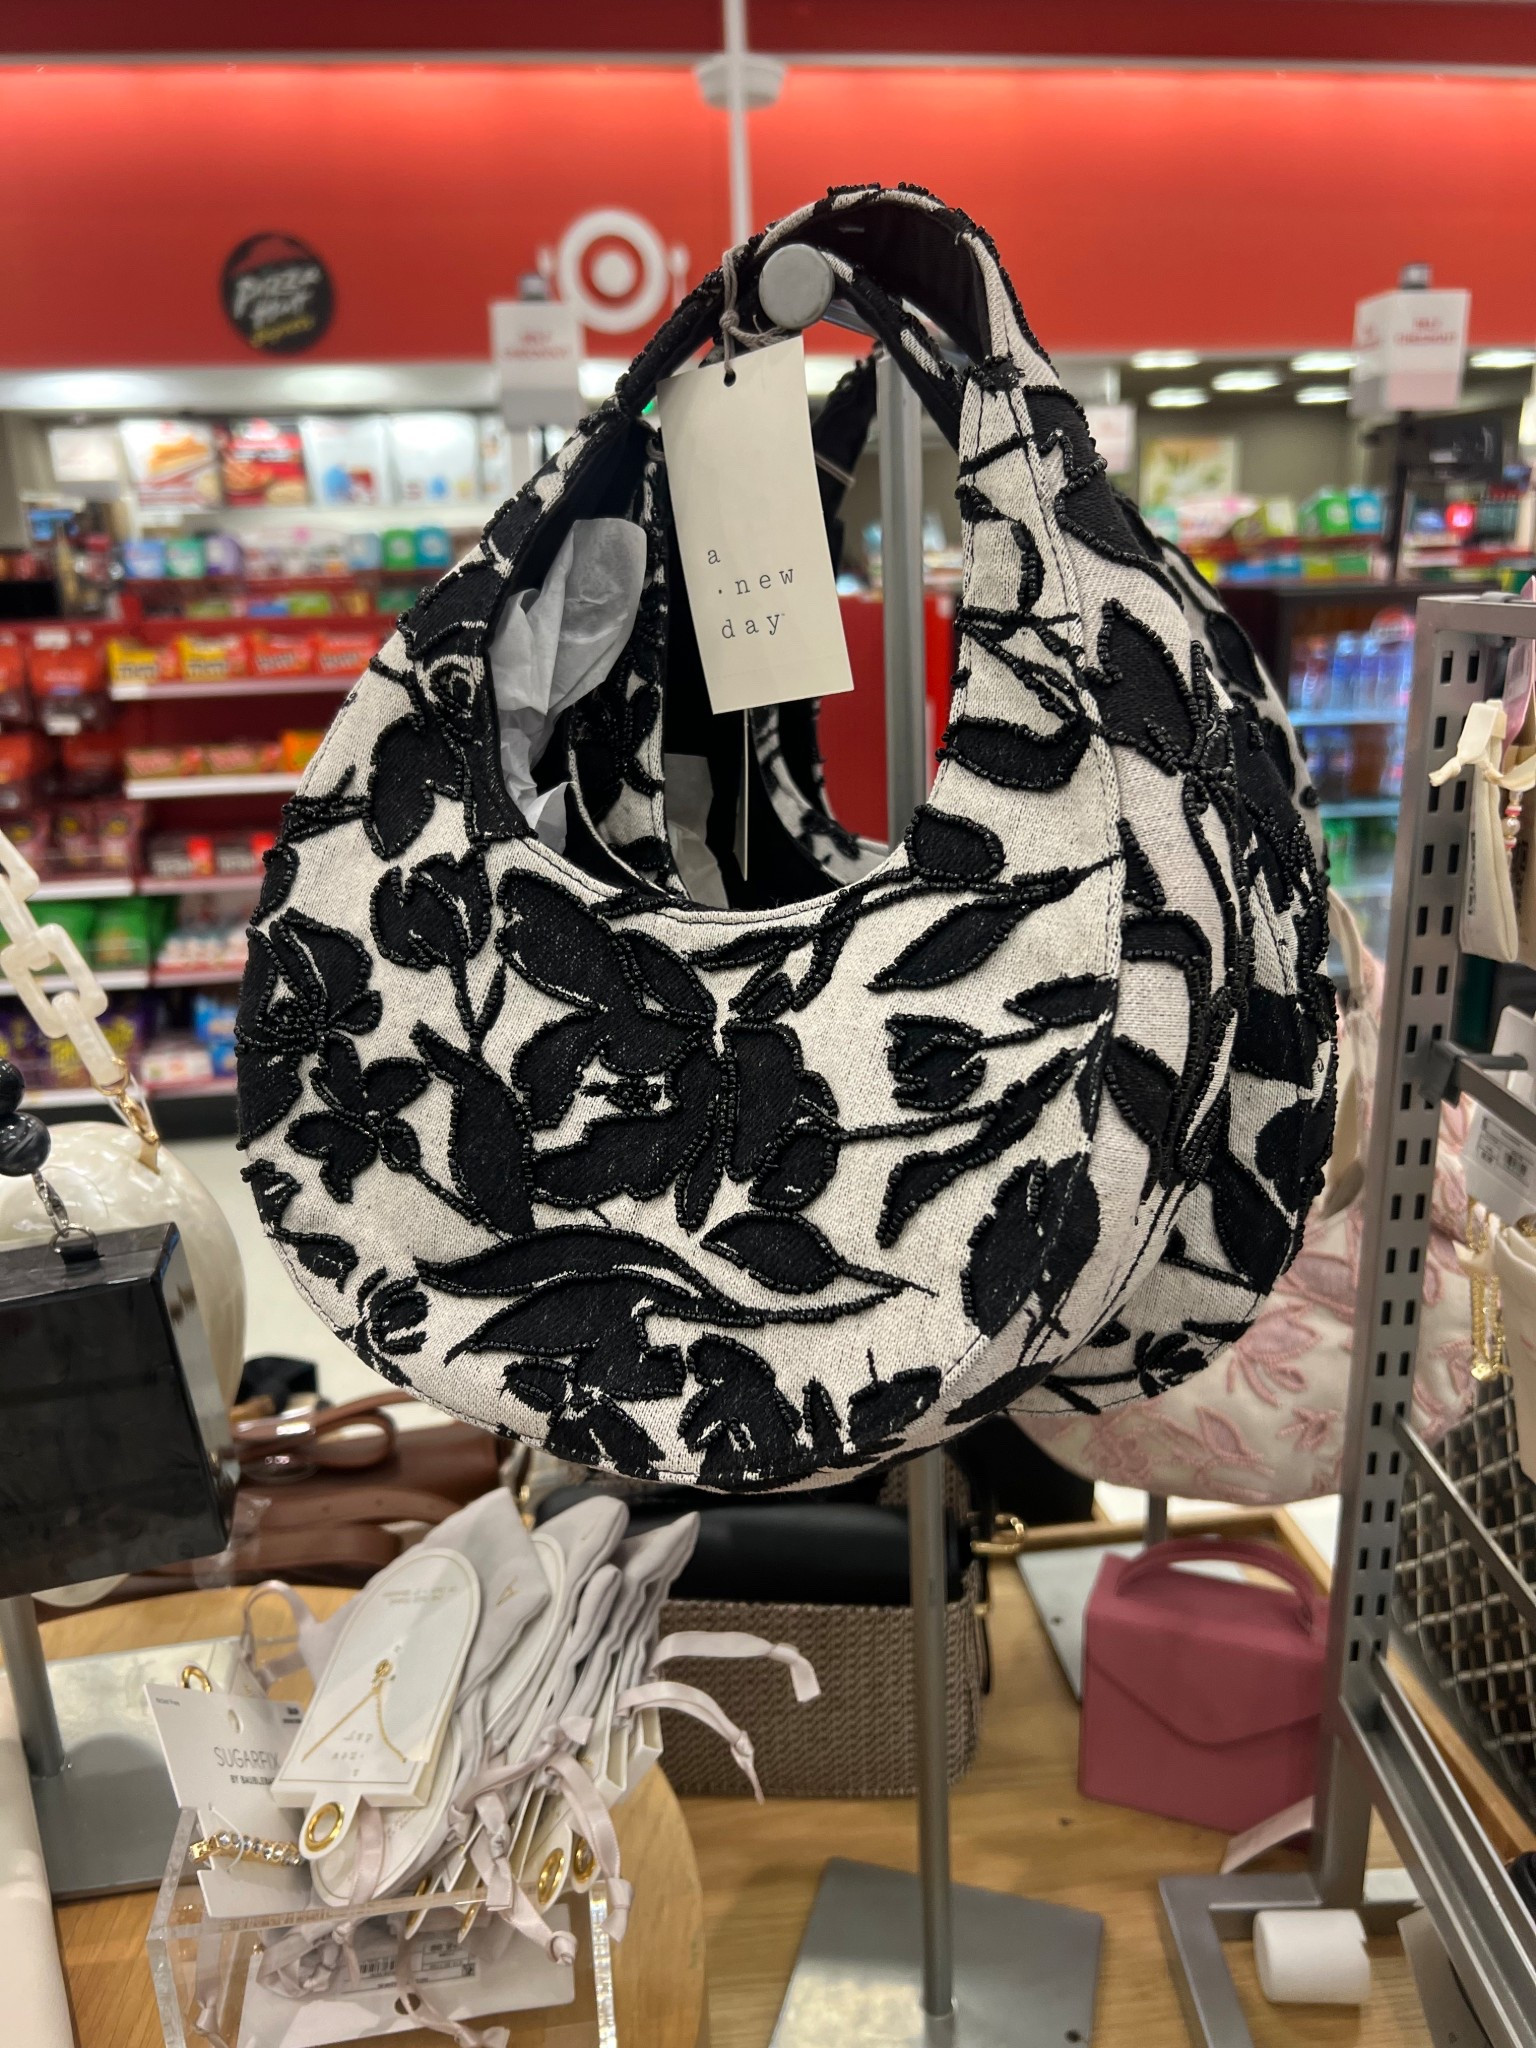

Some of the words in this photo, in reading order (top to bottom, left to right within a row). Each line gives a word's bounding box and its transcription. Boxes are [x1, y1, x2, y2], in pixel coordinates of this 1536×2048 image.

[707, 549, 721, 564] a
[721, 613, 785, 639] day
[214, 1747, 280, 1769] SUGARFIX
